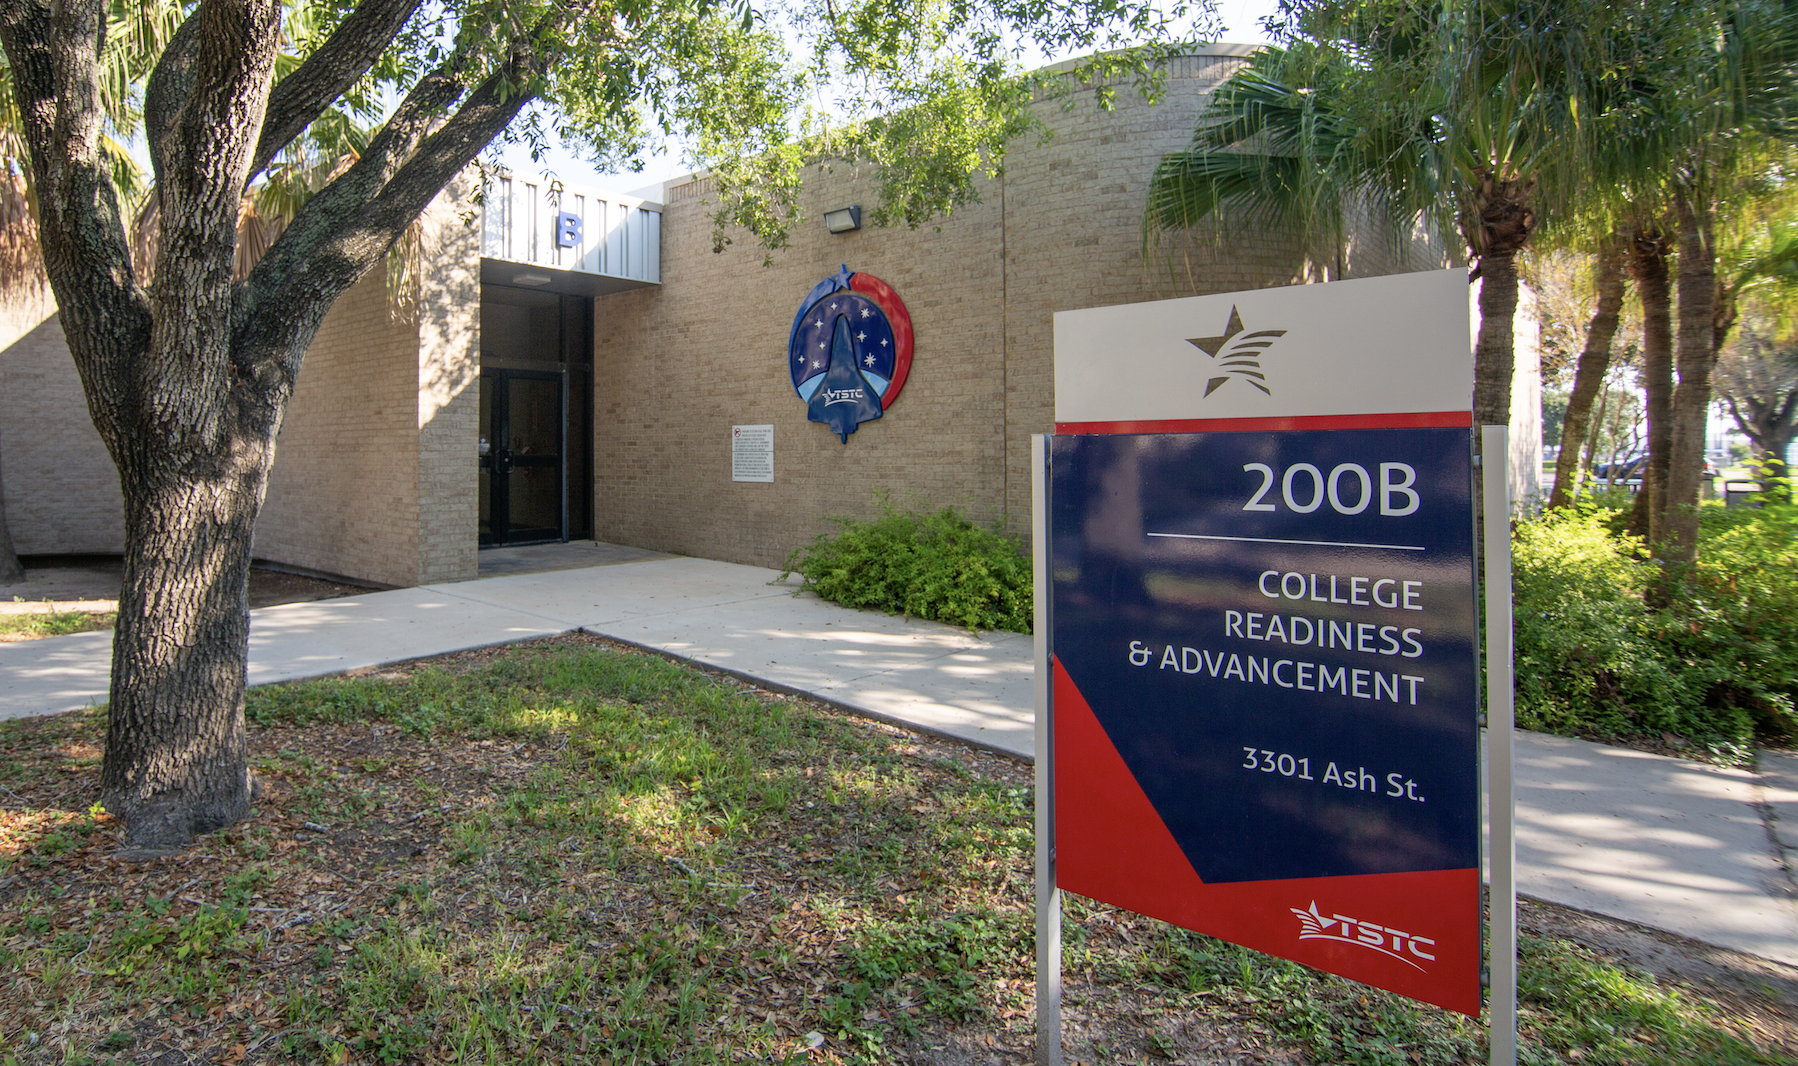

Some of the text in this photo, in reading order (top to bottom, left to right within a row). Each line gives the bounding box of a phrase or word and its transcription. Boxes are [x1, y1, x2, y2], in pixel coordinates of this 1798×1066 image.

[558, 211, 582, 248] B
[834, 388, 863, 399] TSTC
[1242, 462, 1421, 517] 200B
[1258, 570, 1423, 611] COLLEGE
[1225, 610, 1424, 658] READINESS
[1128, 641, 1425, 705] & ADVANCEMENT
[1242, 746, 1426, 802] 3301 Ash St.
[1333, 913, 1436, 961] TSTC
